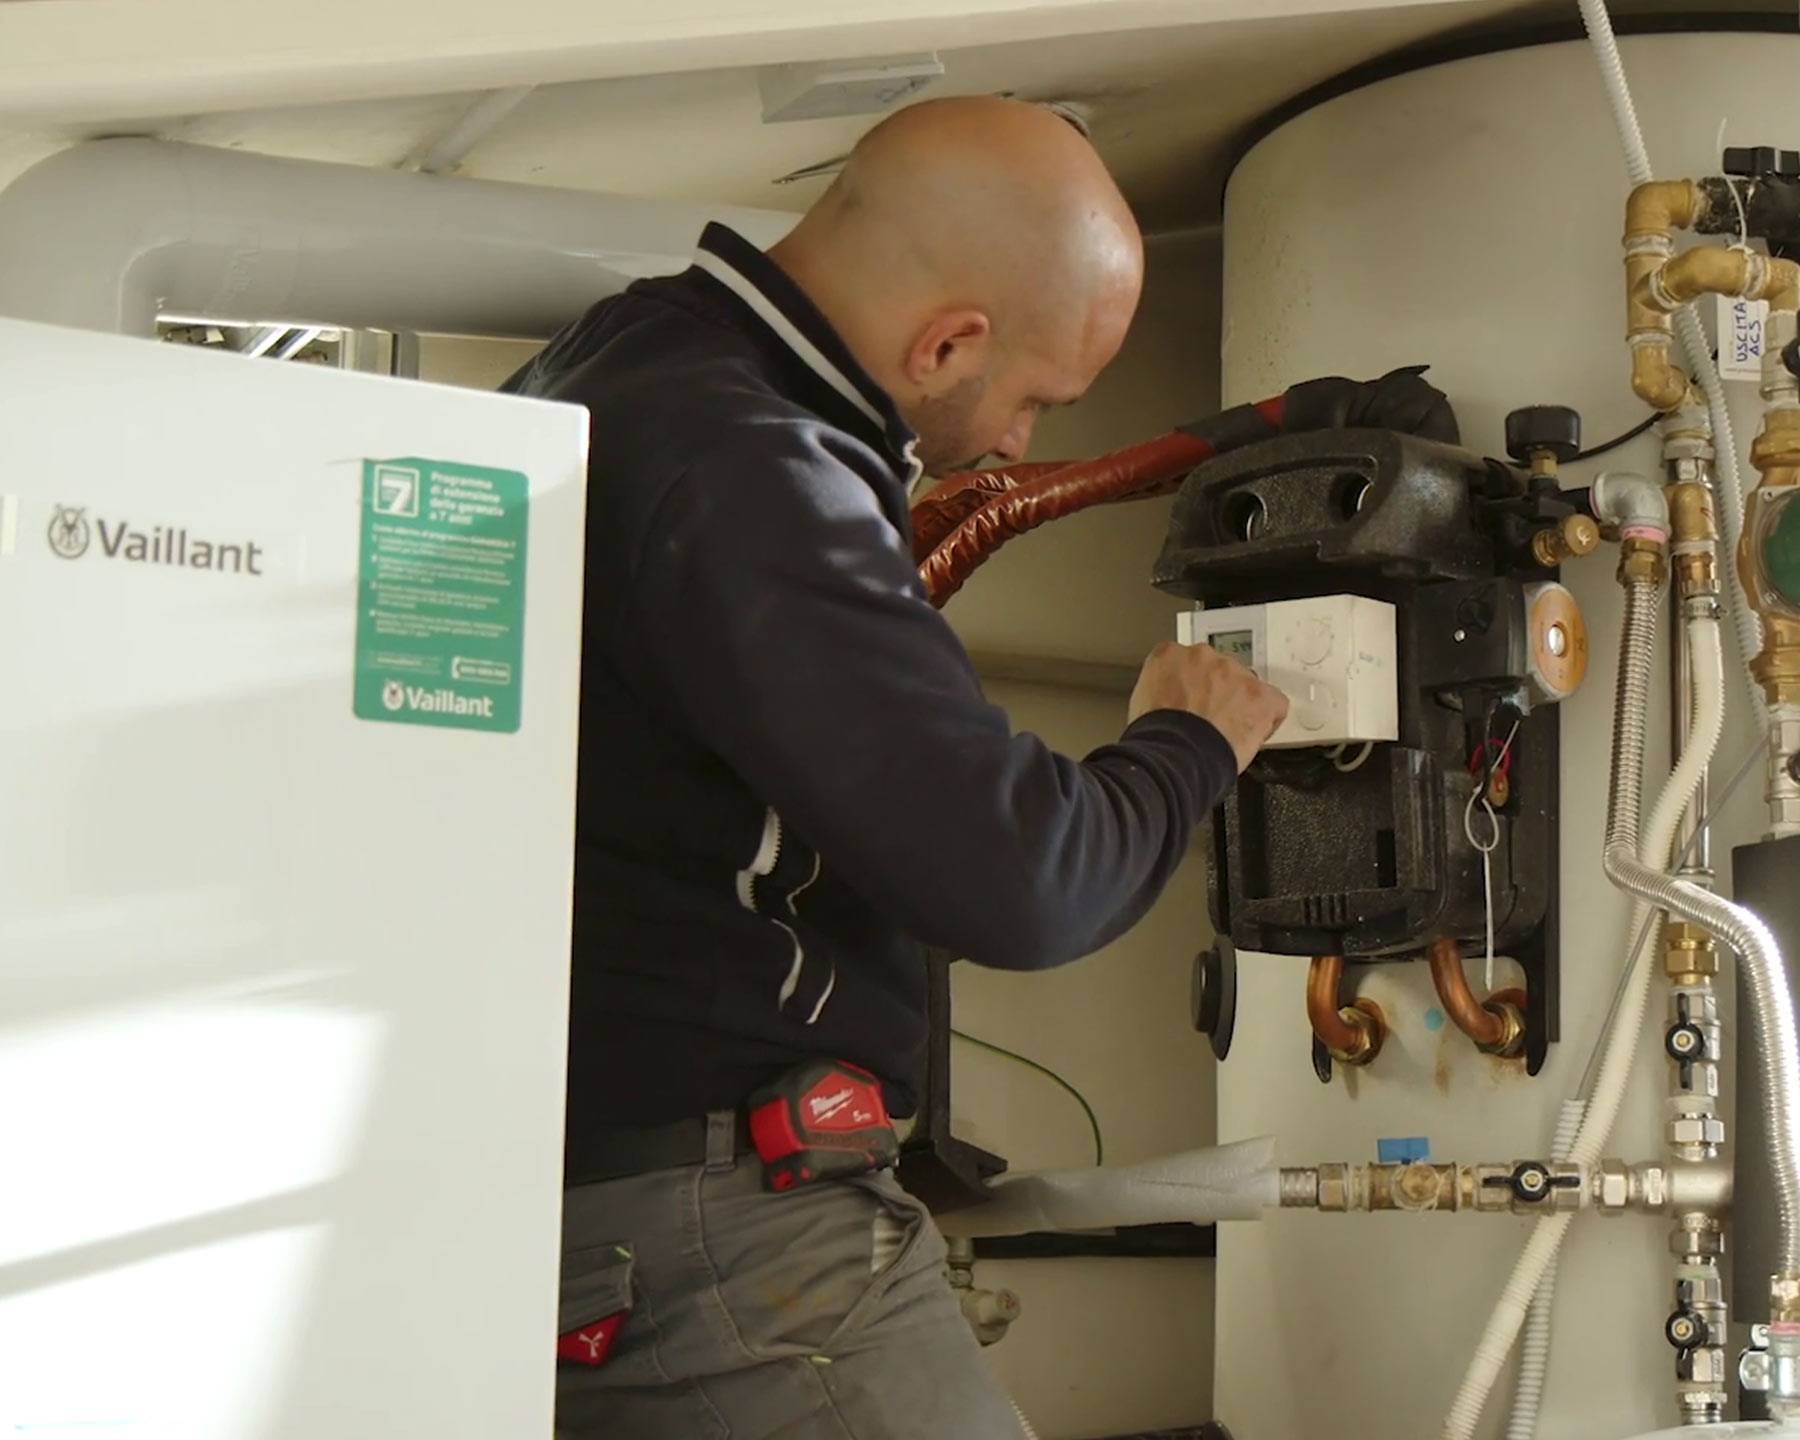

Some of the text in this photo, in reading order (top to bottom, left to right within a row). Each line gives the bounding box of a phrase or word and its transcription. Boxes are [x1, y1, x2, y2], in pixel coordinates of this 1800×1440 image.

[1733, 302, 1748, 362] USCITA
[1749, 321, 1761, 356] ACS
[381, 478, 412, 513] 7
[96, 518, 263, 576] Vaillant
[405, 685, 494, 718] Vaillant
